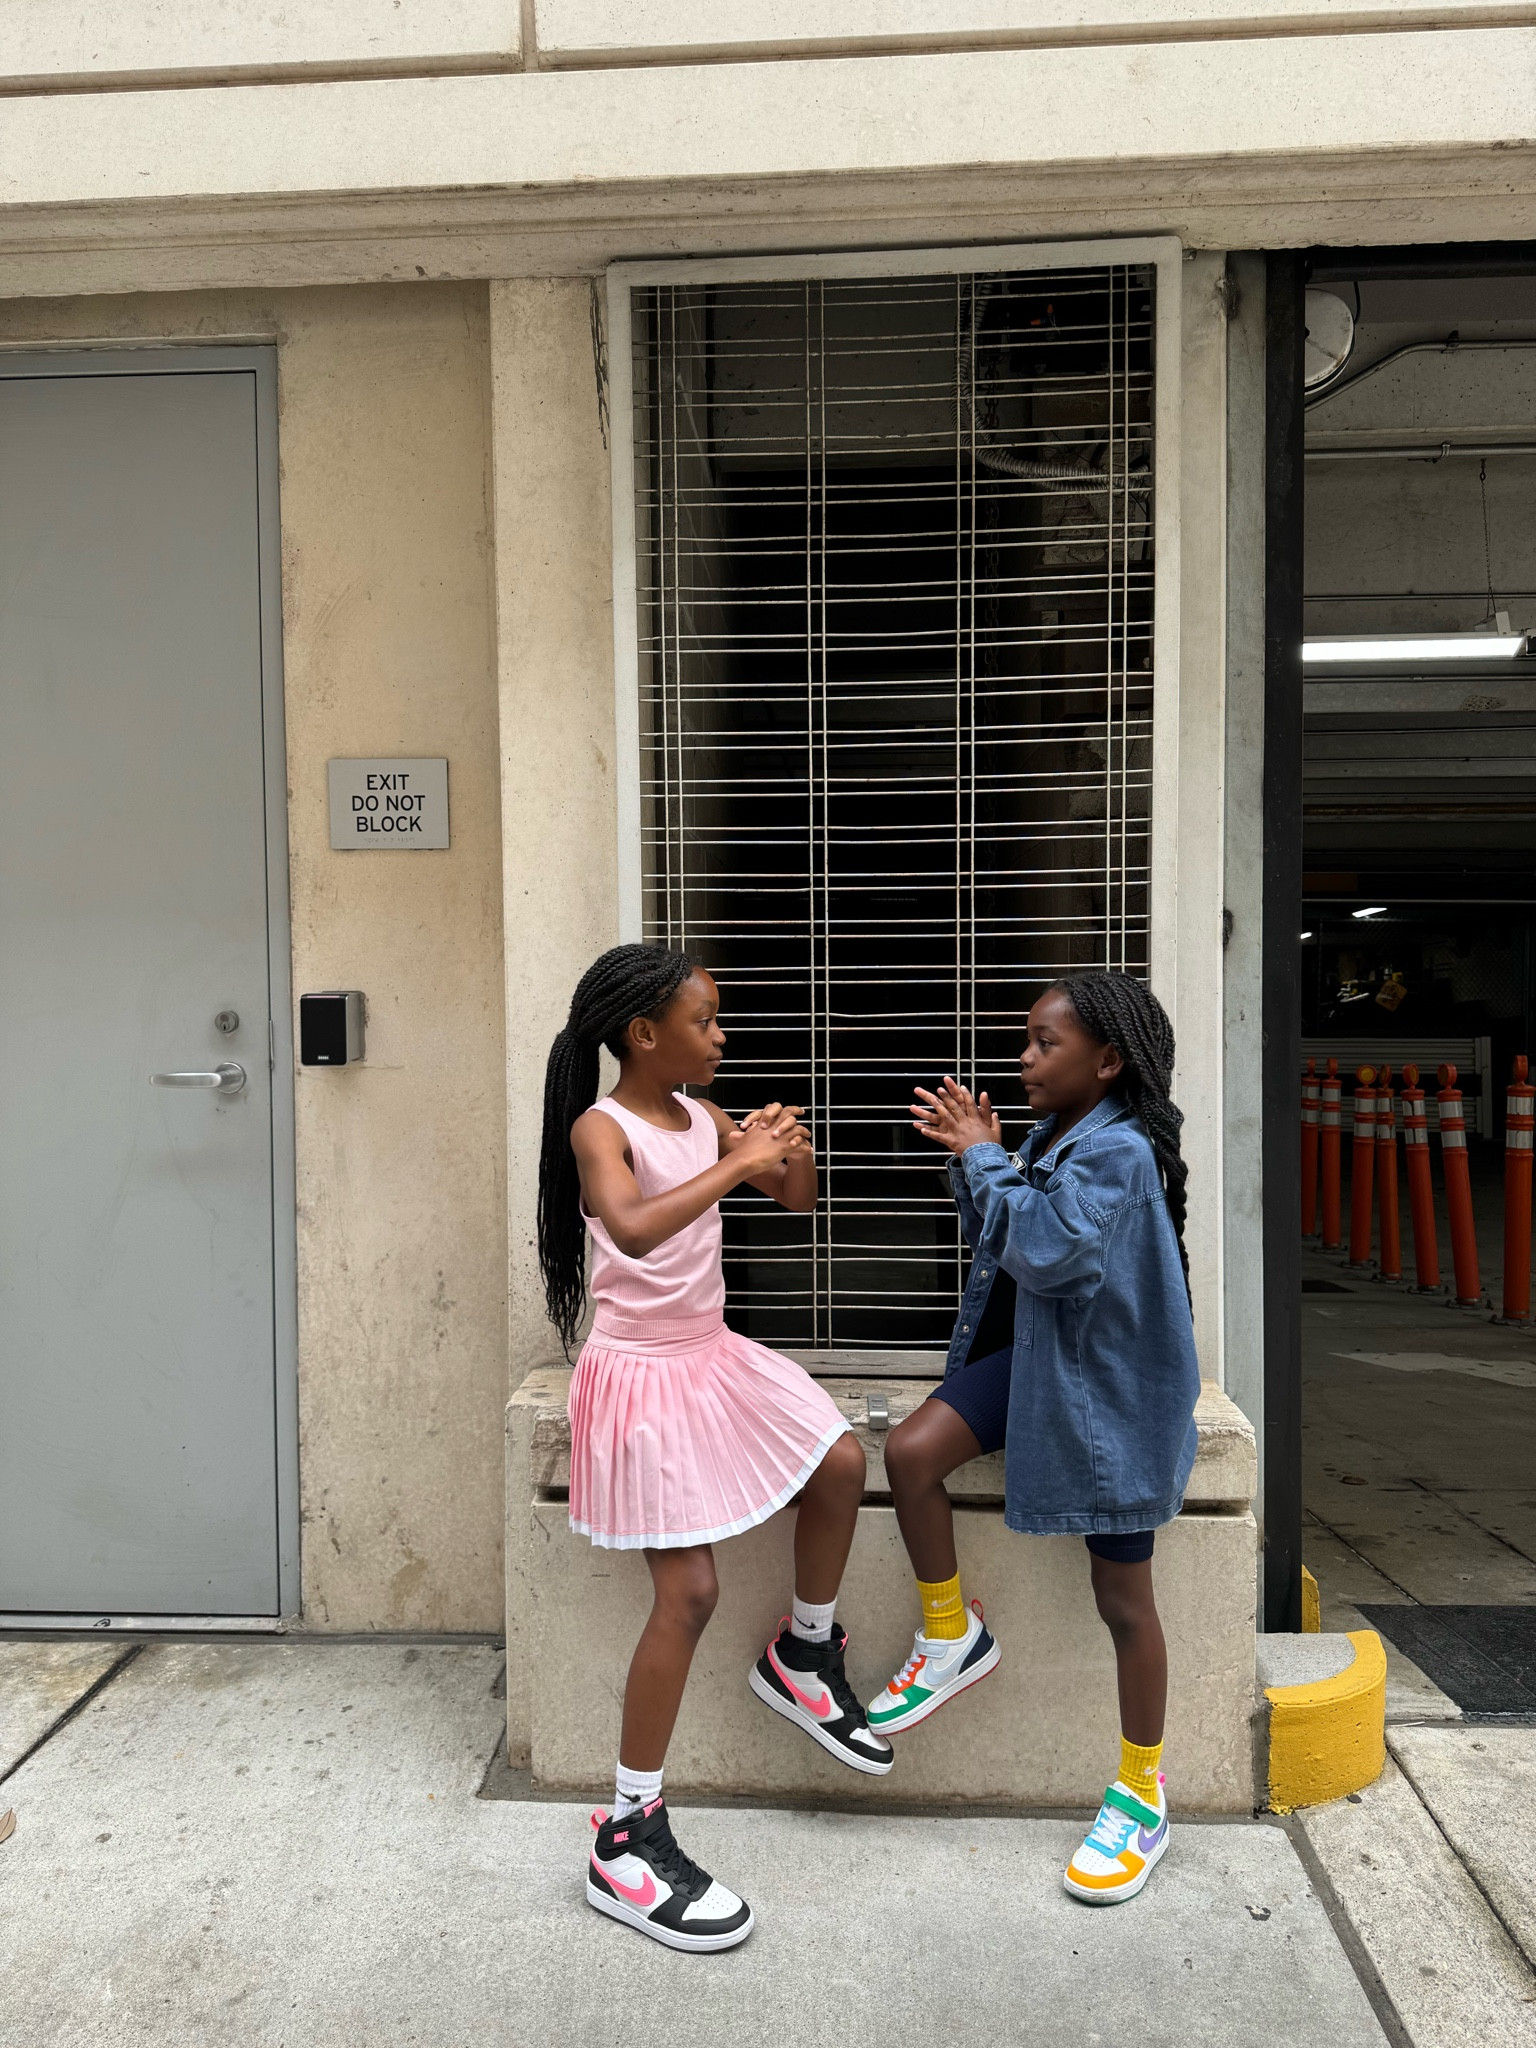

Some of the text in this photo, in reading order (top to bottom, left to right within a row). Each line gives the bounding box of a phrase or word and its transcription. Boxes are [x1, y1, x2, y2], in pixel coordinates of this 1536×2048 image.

[367, 774, 410, 791] EXIT
[352, 795, 426, 811] DO NOT
[356, 815, 422, 832] BLOCK
[613, 1831, 629, 1843] NIKE
